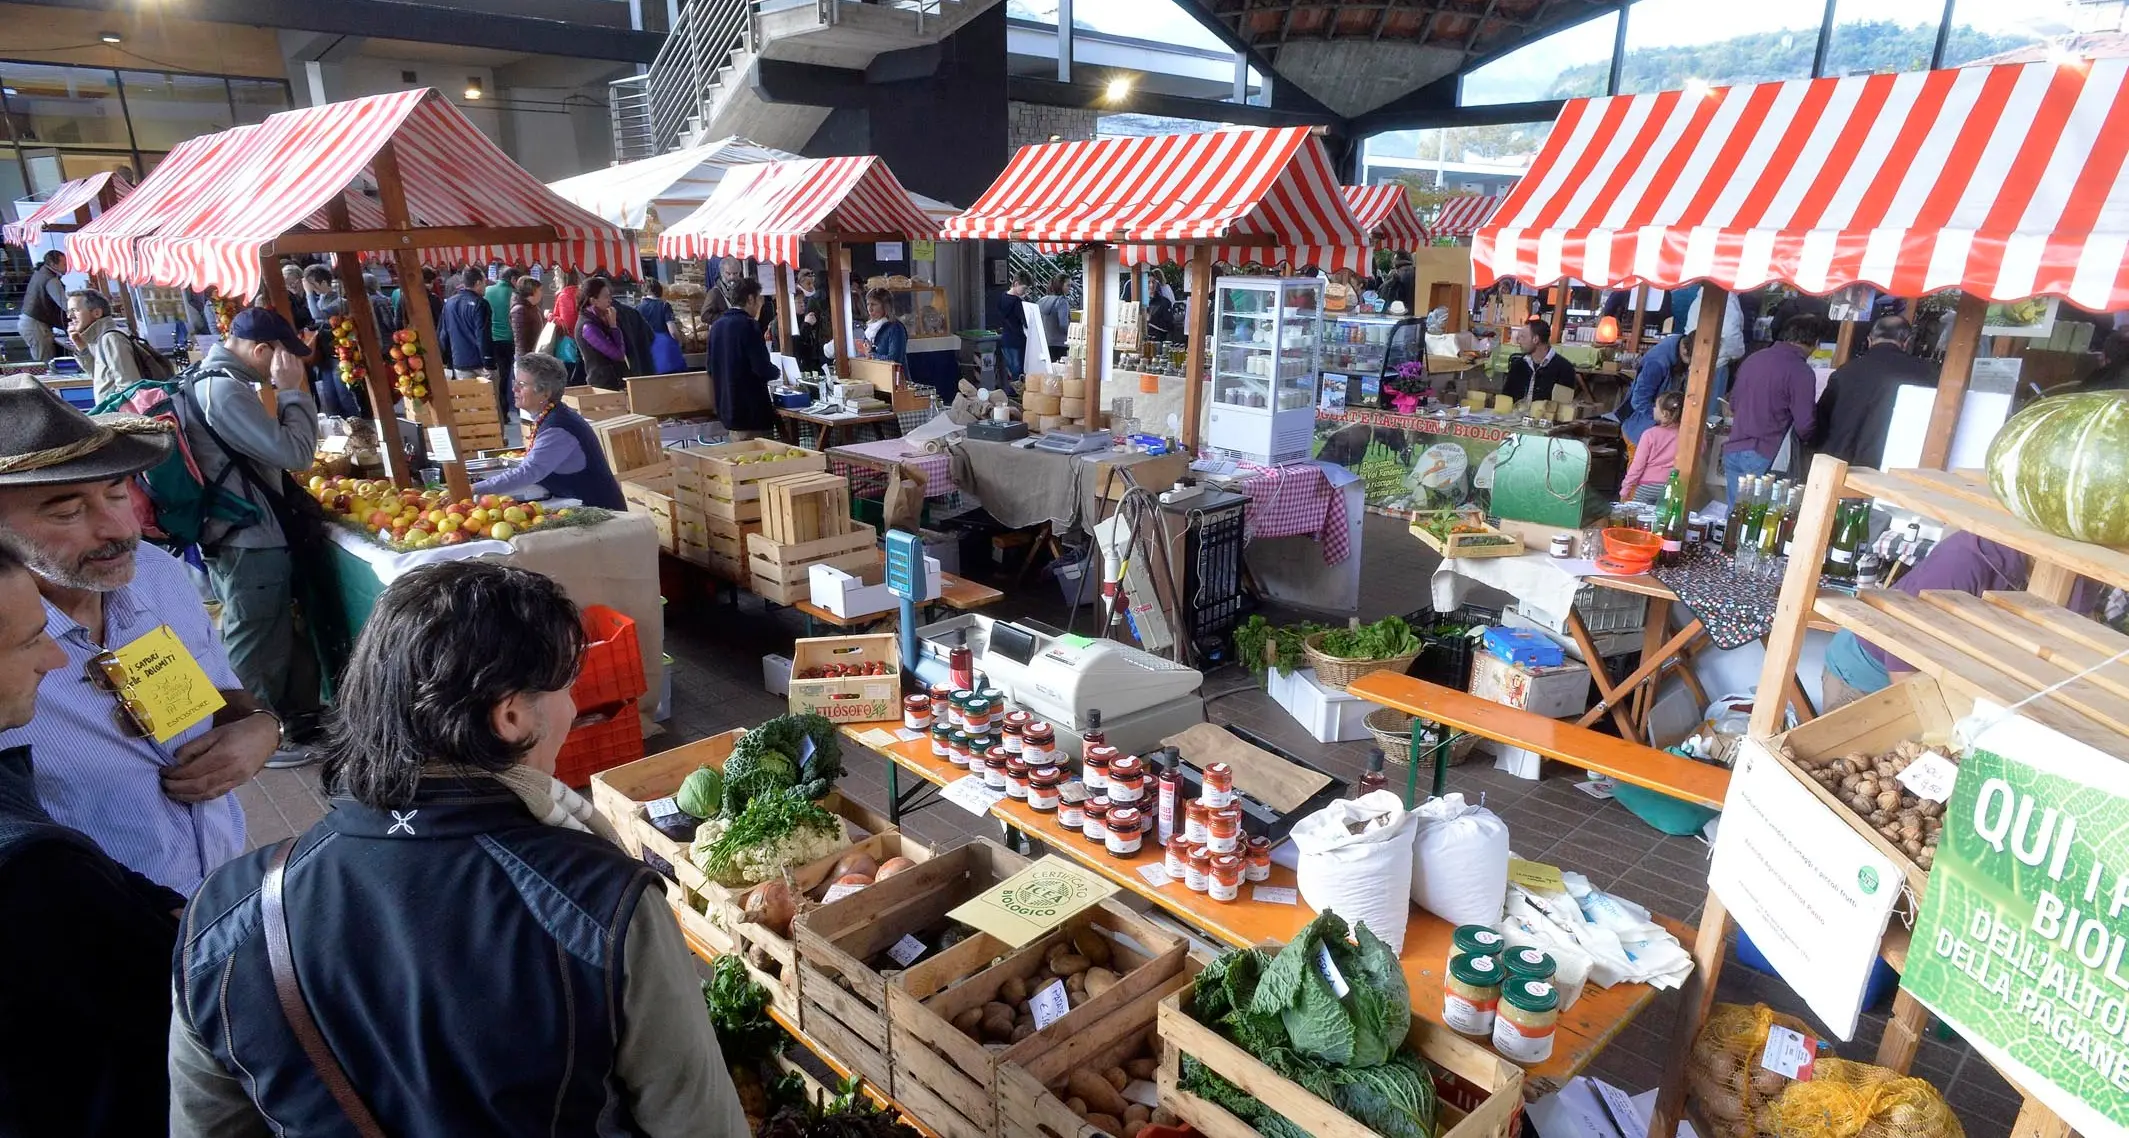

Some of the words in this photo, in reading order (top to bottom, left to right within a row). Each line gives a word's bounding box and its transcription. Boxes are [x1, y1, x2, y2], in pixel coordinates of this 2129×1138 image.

[166, 699, 210, 728] ESPOSITORE
[1973, 777, 2078, 882] QUI
[2082, 858, 2103, 903] I
[1032, 871, 1088, 898] CERTIFICATO
[1839, 889, 1857, 908] frutti
[1001, 889, 1056, 917] BIOLOGICO
[1935, 927, 2012, 1004] DELLA
